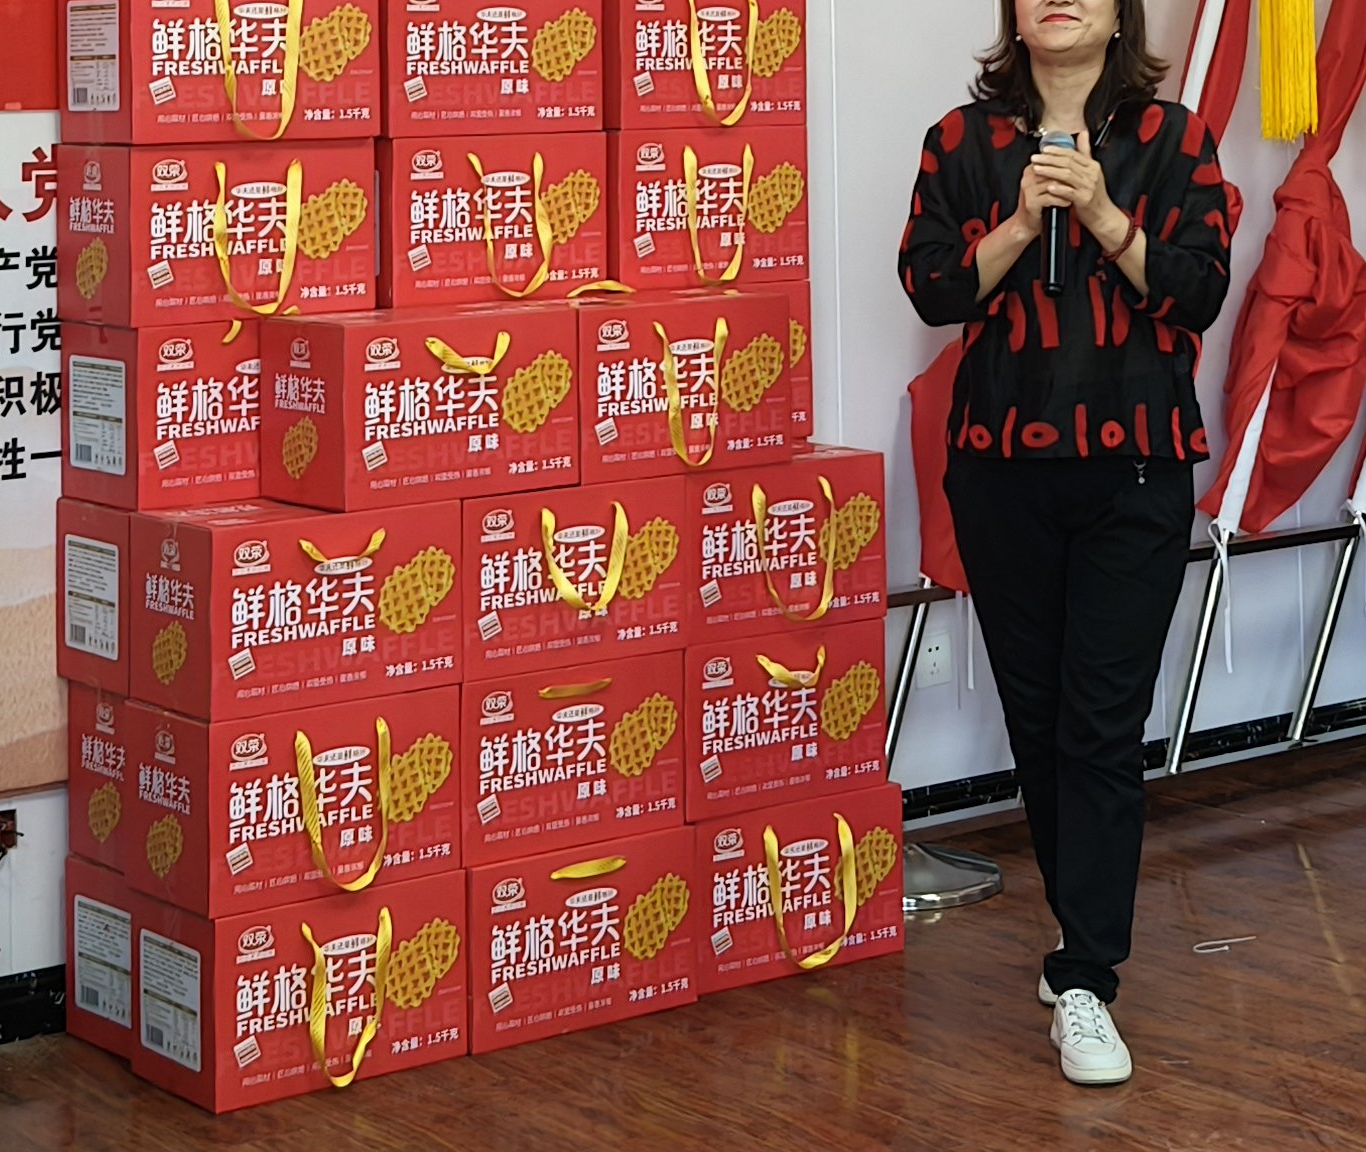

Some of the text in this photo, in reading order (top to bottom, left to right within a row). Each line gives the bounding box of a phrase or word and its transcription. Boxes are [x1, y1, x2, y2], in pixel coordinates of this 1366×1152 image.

[406, 21, 528, 60] 鲜格华夫
[635, 20, 742, 57] 鲜格华夫
[406, 60, 530, 74] FRESHWAFFLE
[718, 74, 743, 90] 原味
[500, 78, 529, 95] 原味
[69, 196, 115, 224] 鲜格华夫
[410, 186, 532, 229] 鲜格华夫
[636, 177, 744, 218] 鲜格华夫
[150, 197, 285, 244] 鲜格华夫
[504, 243, 533, 259] 原味
[275, 372, 325, 404] 鲜格华夫
[364, 372, 498, 425] 鲜格华夫
[365, 412, 499, 441] FRESHWAFFLE
[468, 433, 499, 453] 原味
[702, 513, 816, 565] 鲜格华夫
[145, 572, 194, 610] 鲜格华夫
[790, 570, 817, 589] 原味
[232, 571, 375, 633] 鲜格华夫
[232, 613, 376, 649] FRESHWAFFLE
[342, 634, 375, 657] 原味
[702, 684, 817, 741] 鲜格华夫
[81, 733, 126, 769] 鲜格华夫
[479, 718, 606, 779] 鲜格华夫
[702, 722, 818, 755] FRESHWAFFLE
[791, 741, 818, 761] 原味
[138, 762, 190, 804] 鲜格华夫
[479, 758, 607, 794] FRESHWAFFLE
[577, 778, 607, 800] 原味
[229, 761, 372, 828] 鲜格华夫
[339, 824, 373, 848] 原味
[712, 853, 831, 913] 鲜格华夫
[491, 903, 619, 968] 鲜格华夫
[804, 909, 832, 930] 原味
[491, 941, 621, 984] FRESHWAFFLE
[590, 962, 620, 985] 原味
